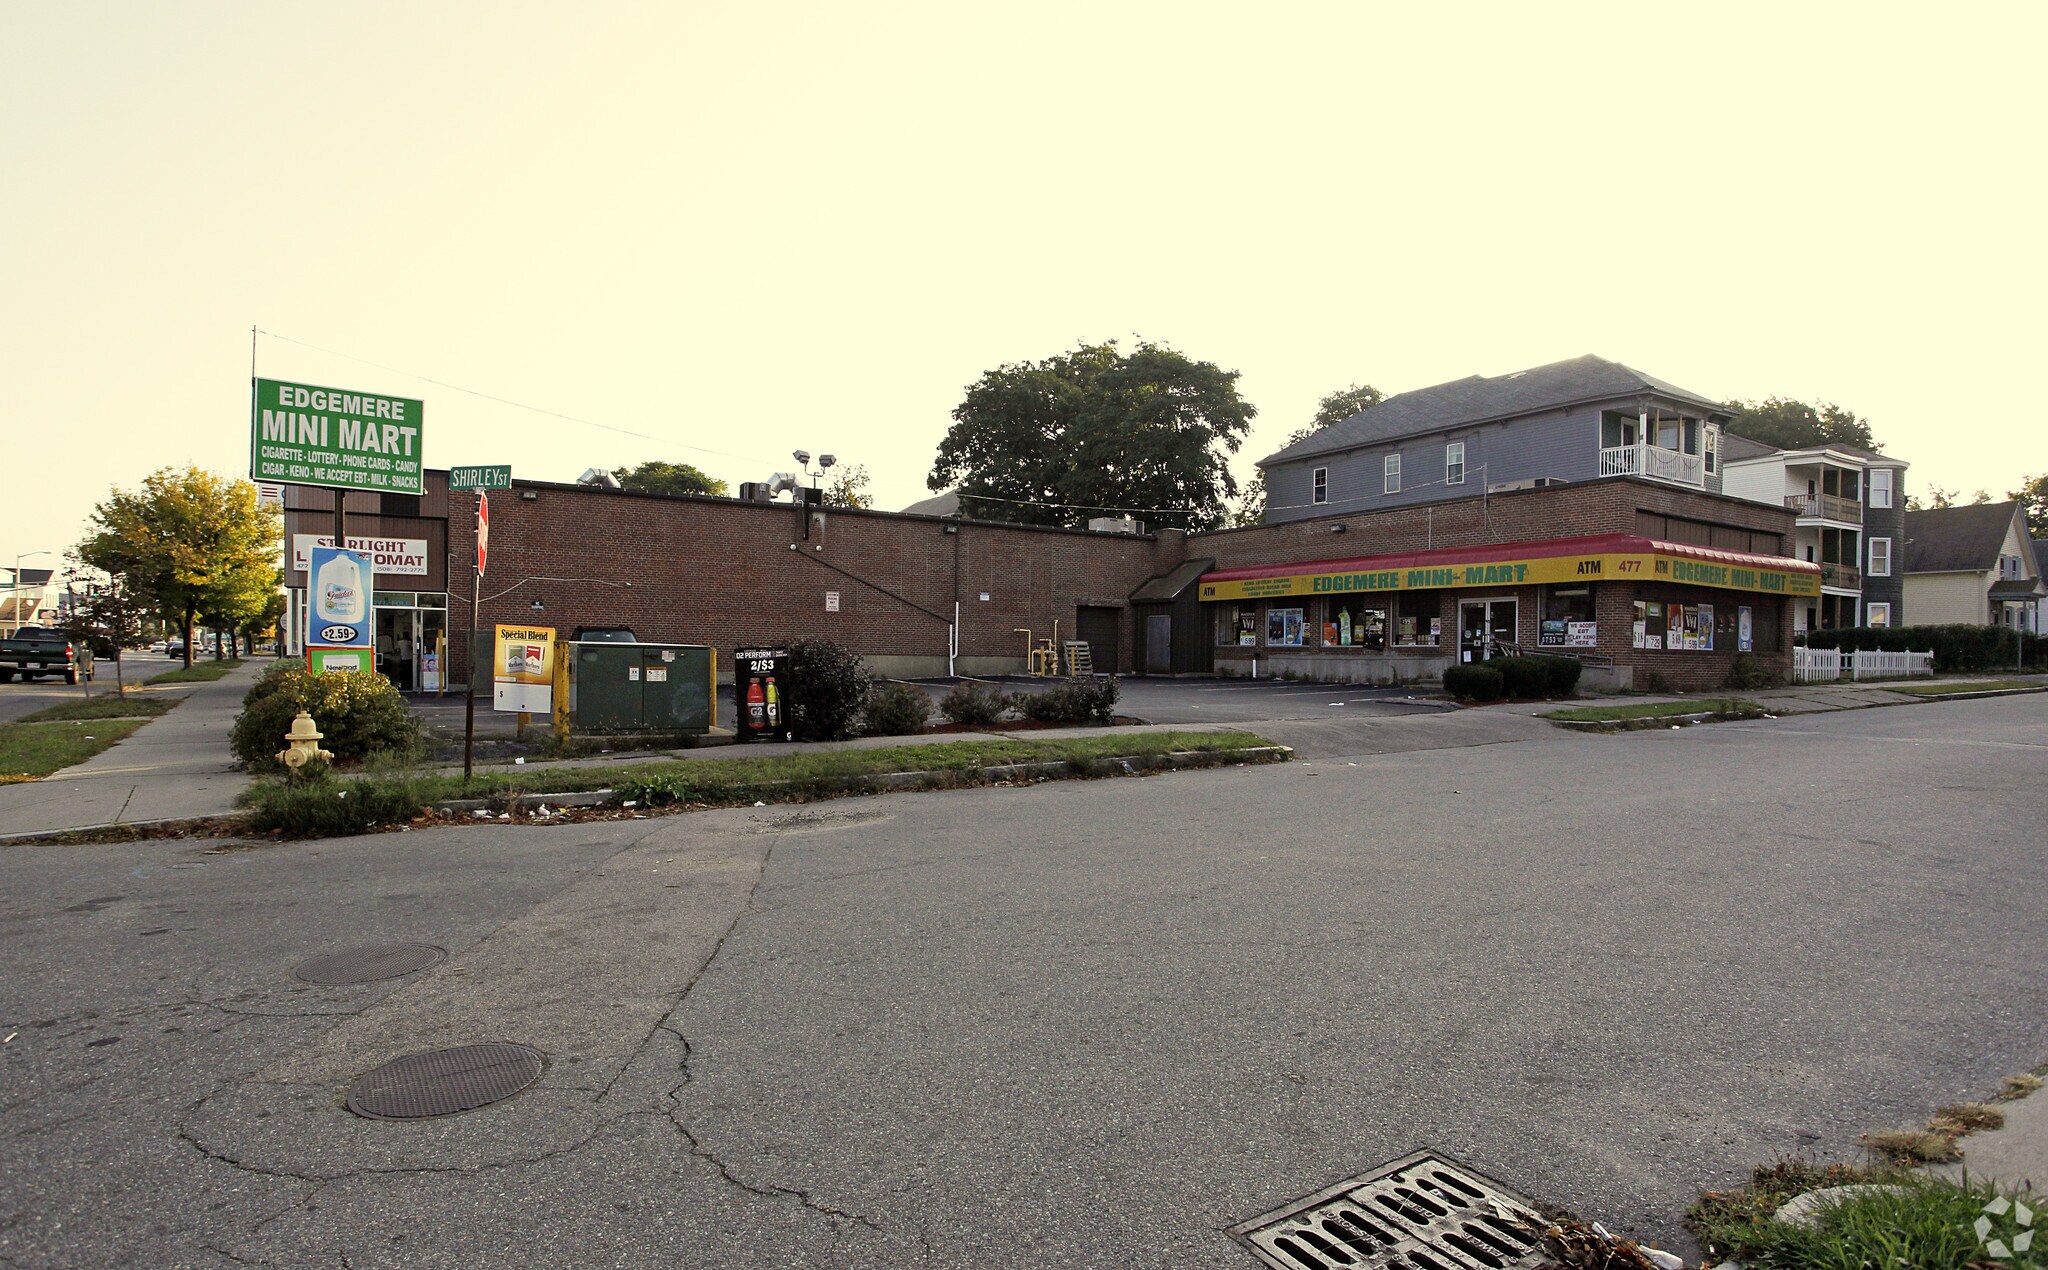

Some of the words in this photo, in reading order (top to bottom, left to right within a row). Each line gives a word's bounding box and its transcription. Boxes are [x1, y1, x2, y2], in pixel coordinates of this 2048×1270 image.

[279, 385, 405, 421] EDGEMERE
[262, 409, 328, 447] MINI
[339, 418, 417, 456] MART
[261, 445, 303, 462] CIGARETTE
[308, 450, 339, 465] LOTTERY
[342, 454, 367, 468] PHONE
[367, 457, 391, 471] CARDS
[395, 460, 418, 473] CANDY
[261, 462, 285, 476] CIGAR
[289, 465, 310, 478] KENO
[314, 467, 326, 480] WE
[326, 468, 354, 483] ACCEPT
[354, 472, 367, 484] EBT
[370, 473, 388, 486] MILK
[391, 475, 418, 488] SNACKS
[452, 469, 499, 487] SHIRLEY
[317, 538, 406, 552] STRLIGHT
[1576, 560, 1601, 574] ATM
[1619, 560, 1641, 572] 477
[1313, 572, 1399, 592] EDGEMERE
[1465, 564, 1528, 584] MART
[1654, 559, 1668, 574] ATM
[1673, 560, 1728, 585] EDGEMERE
[1760, 572, 1787, 592] MART
[1203, 587, 1216, 597] ATM
[324, 628, 349, 639] $2.59
[501, 629, 526, 640] Special
[528, 630, 548, 641] Blend
[744, 651, 771, 659] PERFORM
[750, 659, 774, 671] 2/$3
[499, 690, 504, 698] $
[750, 707, 763, 716] G2
[767, 703, 776, 716] G
